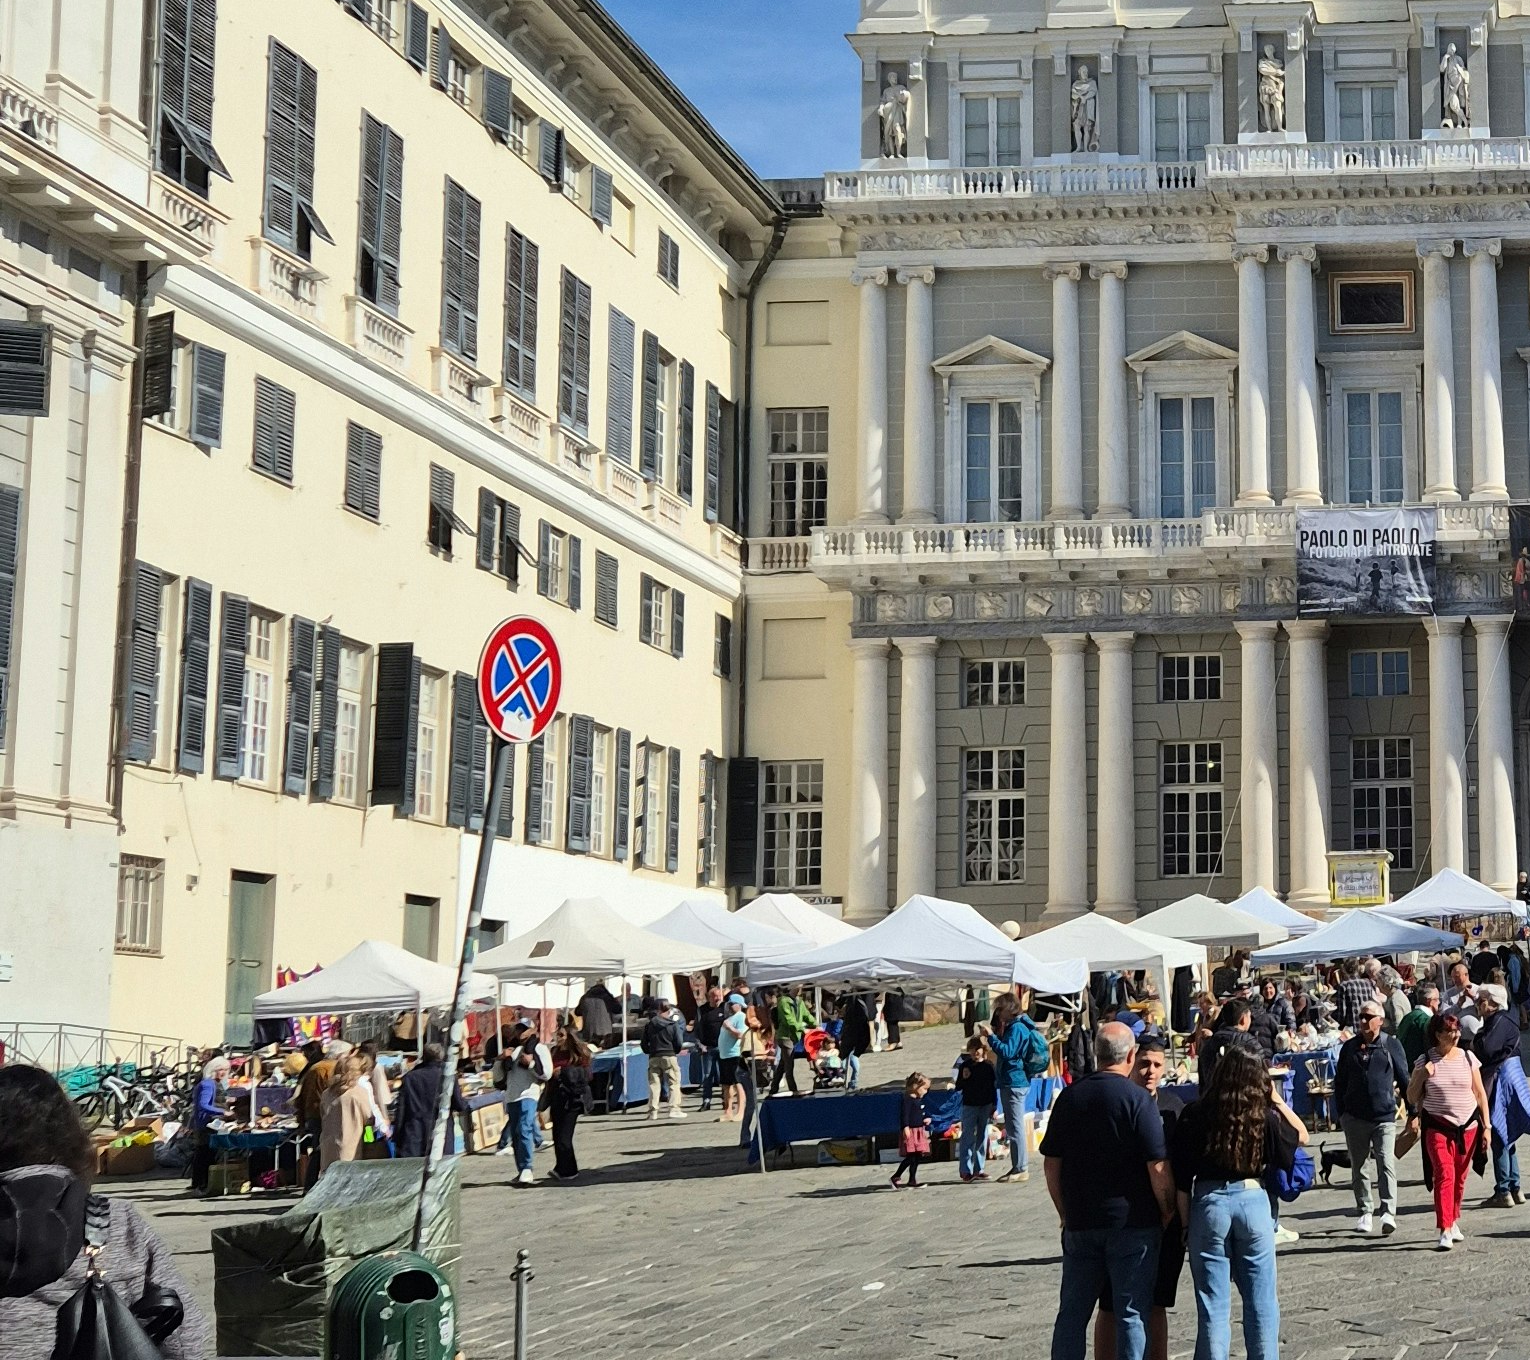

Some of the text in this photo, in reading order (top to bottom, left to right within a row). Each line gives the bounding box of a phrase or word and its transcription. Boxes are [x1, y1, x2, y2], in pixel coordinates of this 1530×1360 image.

[1300, 527, 1420, 548] PAOLO DI PAOLO
[1309, 543, 1433, 558] FOTOGRAFIE RITROVATE
